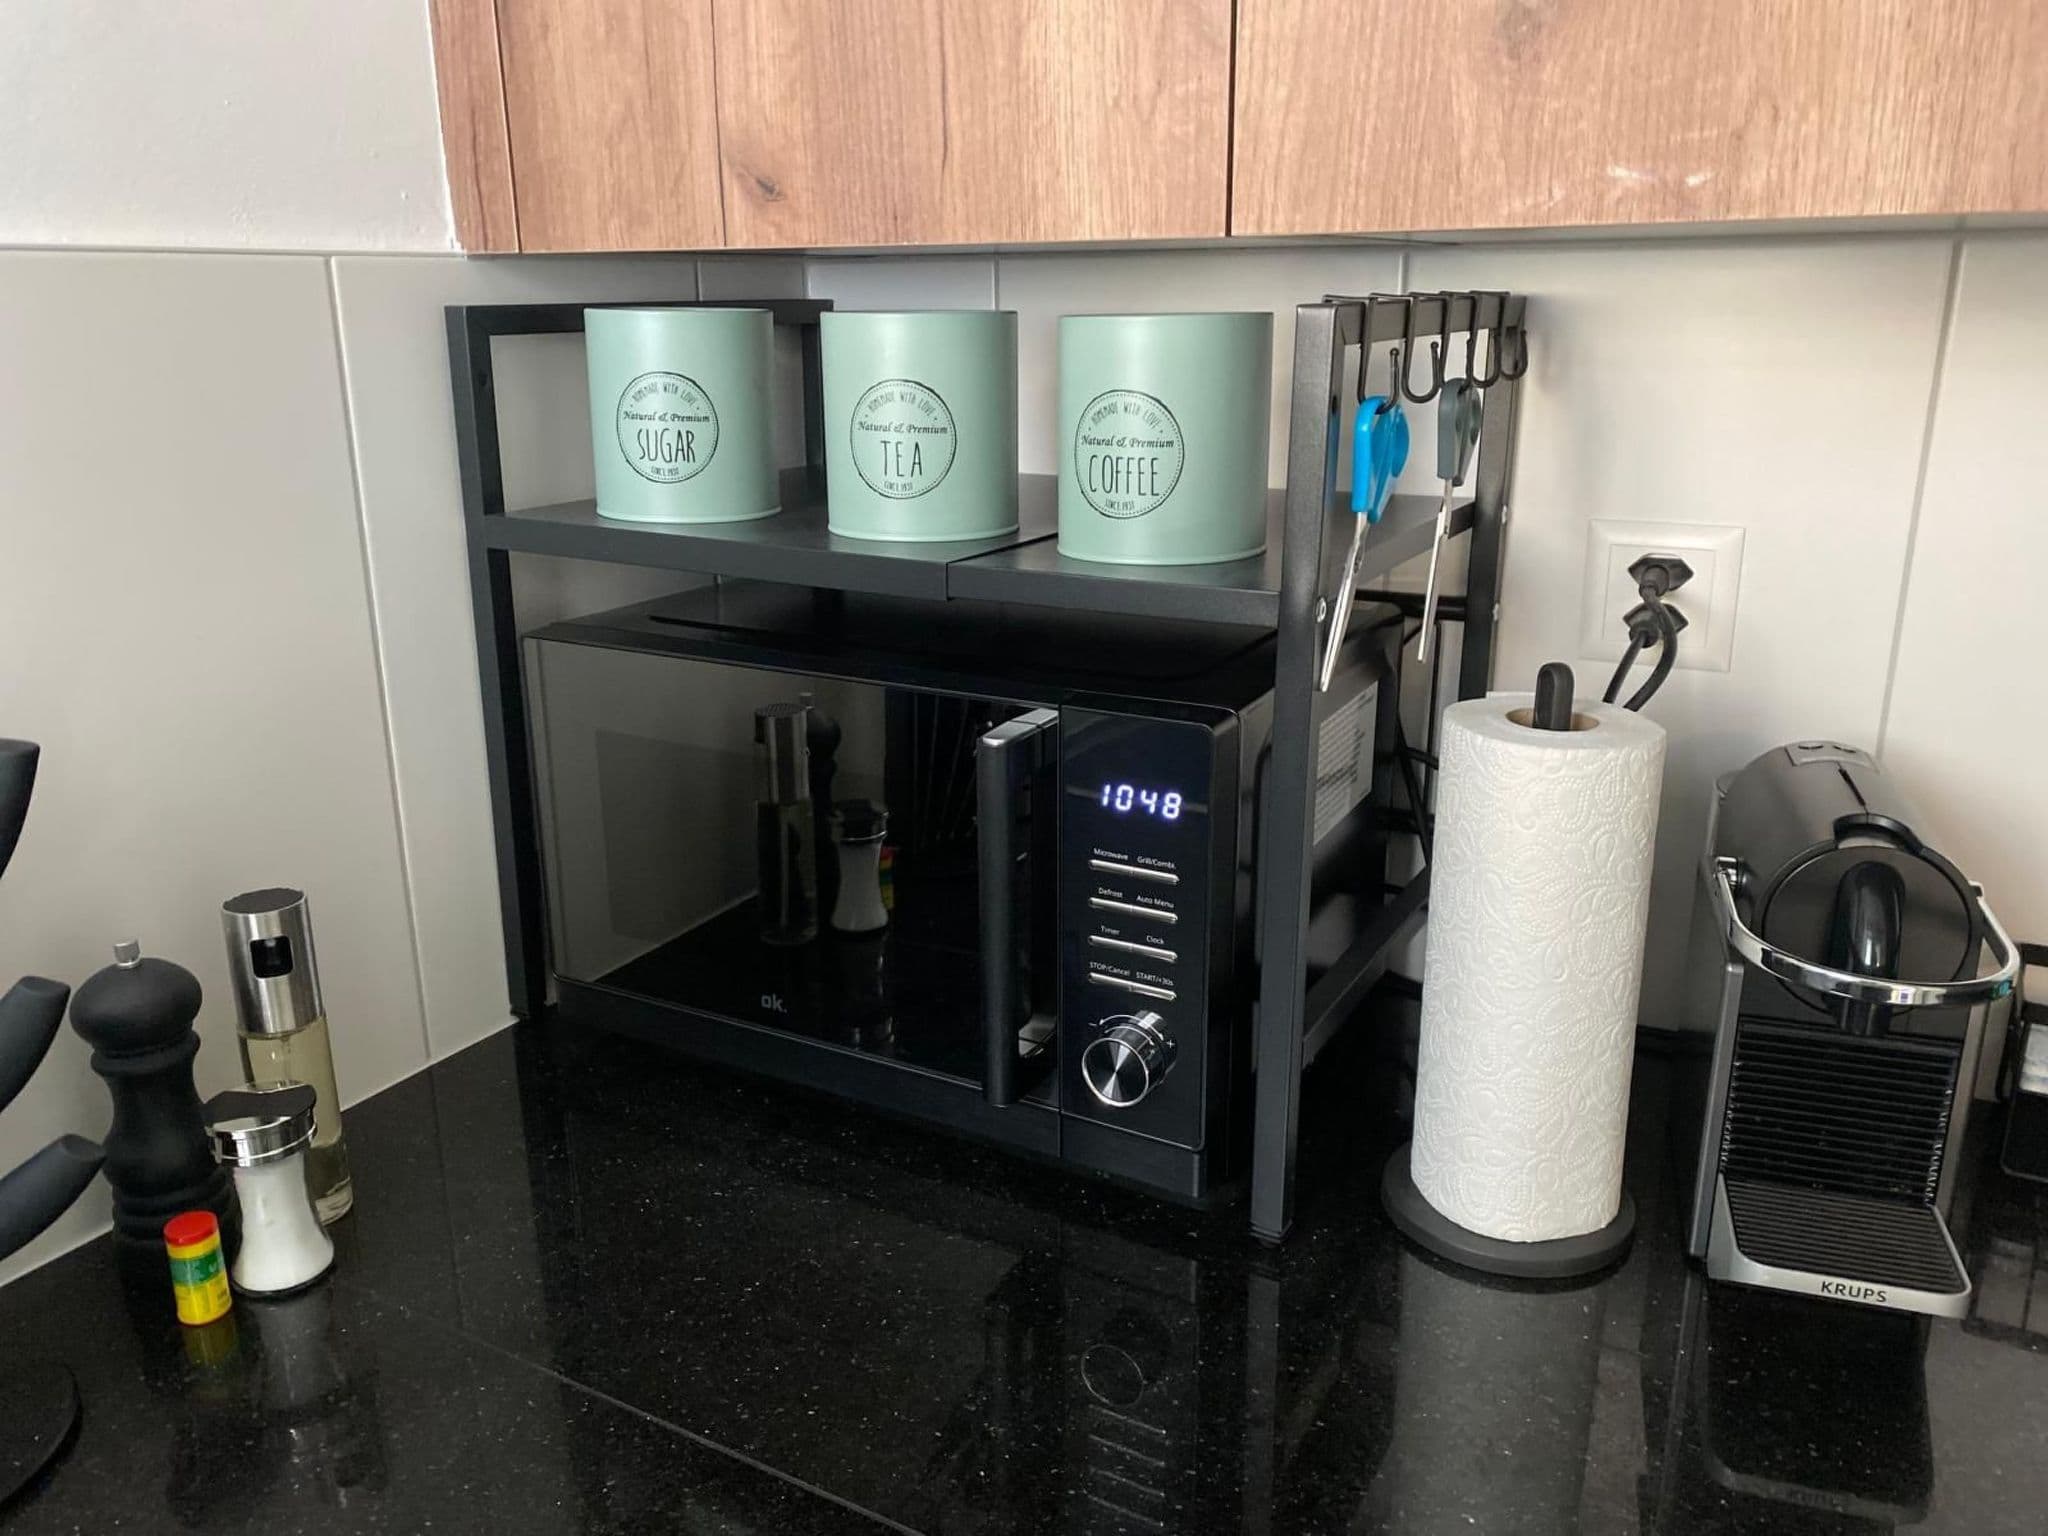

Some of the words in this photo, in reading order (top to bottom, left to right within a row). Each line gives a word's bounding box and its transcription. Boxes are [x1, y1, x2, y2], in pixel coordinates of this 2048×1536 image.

[623, 410, 657, 422] Natural
[670, 413, 710, 423] Premium
[858, 421, 892, 432] Natural
[906, 423, 948, 434] Premium
[637, 428, 696, 463] SUGAR
[1081, 434, 1115, 447] Natural
[1129, 438, 1174, 448] Premium
[880, 440, 922, 478] TEA
[1088, 454, 1160, 497] COFFEE
[1093, 847, 1129, 860] Microwave
[1098, 887, 1123, 898] Defrost
[1136, 895, 1153, 905] Auto
[1154, 898, 1174, 908] Menu
[1101, 925, 1120, 935] Timer
[1146, 935, 1164, 945] Clock
[1089, 961, 1130, 976] STOP/Cancel
[1820, 1280, 1888, 1303] KRUPS
